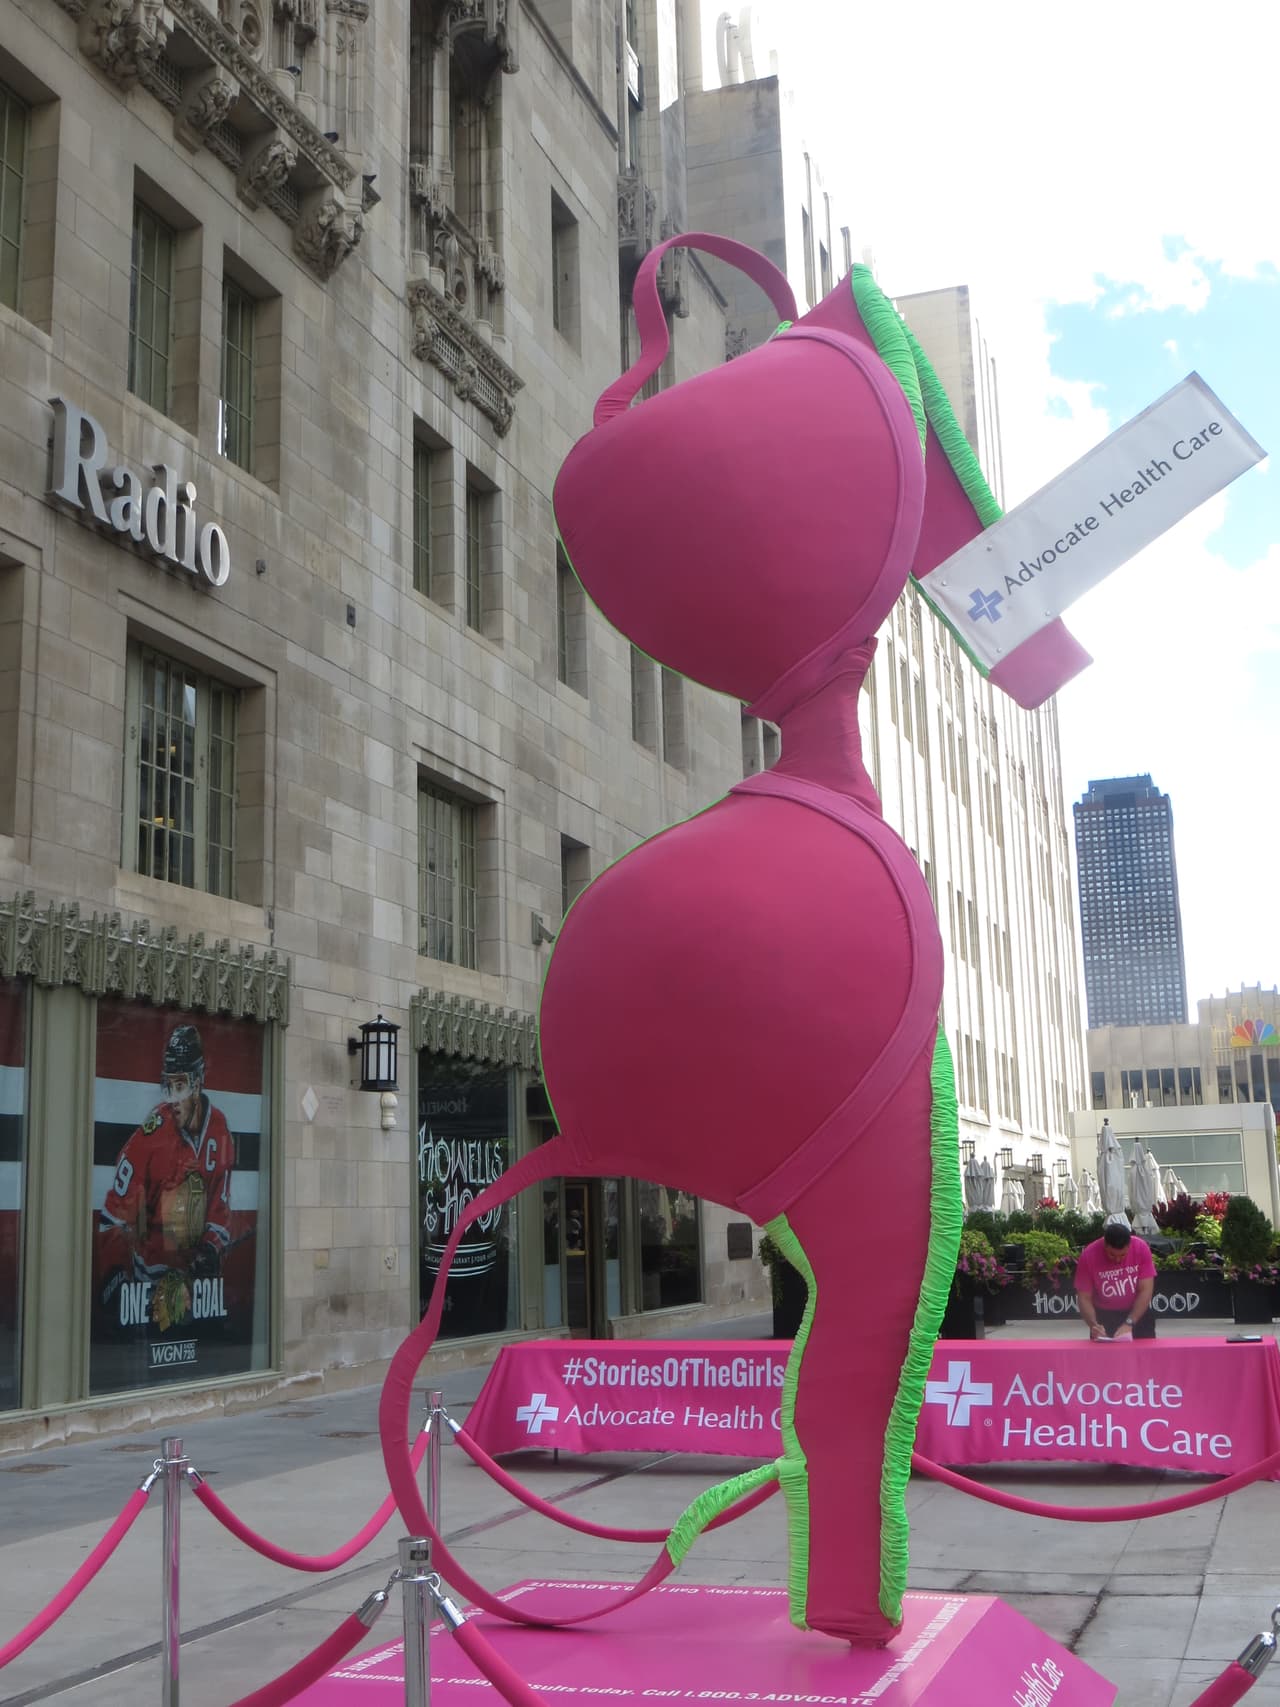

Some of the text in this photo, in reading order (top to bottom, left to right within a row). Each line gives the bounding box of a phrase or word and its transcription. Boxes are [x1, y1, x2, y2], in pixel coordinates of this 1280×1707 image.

[47, 396, 231, 586] Radio
[1002, 420, 1223, 595] Advocate Health Care
[205, 1138, 217, 1172] C
[418, 1121, 503, 1185] HOWELLS
[113, 1152, 134, 1198] 9
[424, 1188, 438, 1232] &
[120, 1281, 152, 1326] ONE
[193, 1277, 228, 1319] GOAL
[1149, 1292, 1200, 1312] OOD
[152, 1343, 183, 1364] WGN
[562, 1357, 785, 1388] #StoriesOfTheGirls
[1003, 1371, 1183, 1409] Advocate
[564, 1404, 675, 1426] Advocate
[683, 1406, 763, 1430] Health
[1002, 1413, 1232, 1459] Health Care
[1031, 1658, 1064, 1691] Care
[528, 1683, 577, 1693] sults
[580, 1686, 636, 1697] today.
[641, 1688, 681, 1698] Call
[684, 1690, 877, 1706] 1.800.3.ADVOCATE
